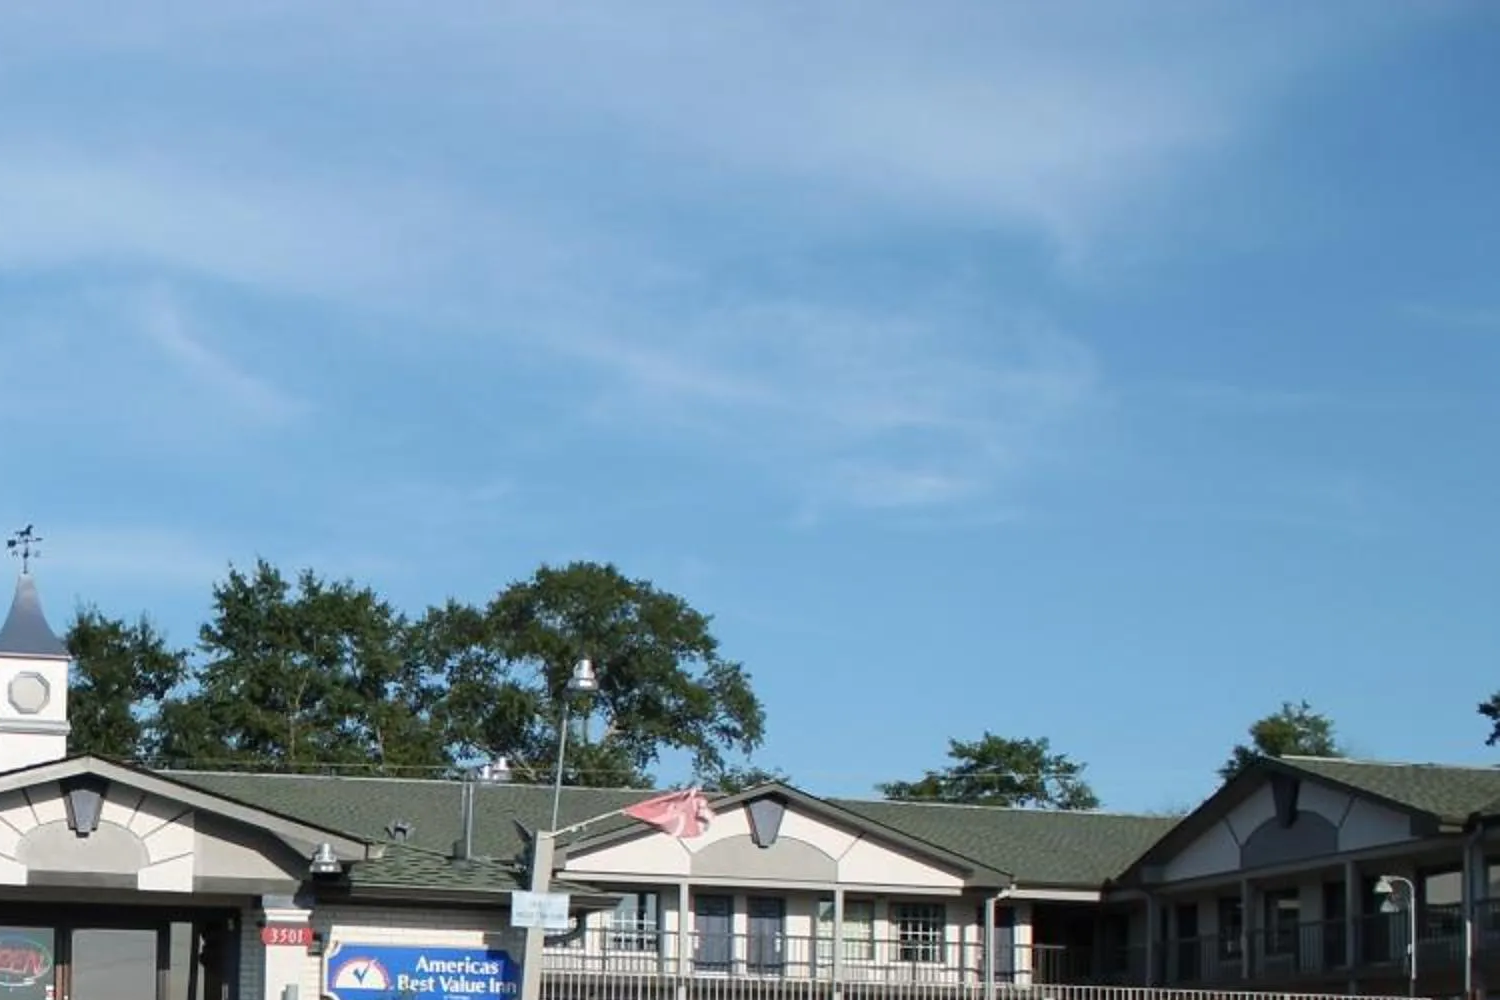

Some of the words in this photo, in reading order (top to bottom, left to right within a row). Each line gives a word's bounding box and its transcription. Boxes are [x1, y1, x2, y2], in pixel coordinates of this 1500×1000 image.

[270, 927, 303, 944] 3501
[415, 955, 500, 975] Americas
[397, 974, 435, 993] Best
[439, 975, 486, 994] Value
[489, 977, 517, 995] Inn
